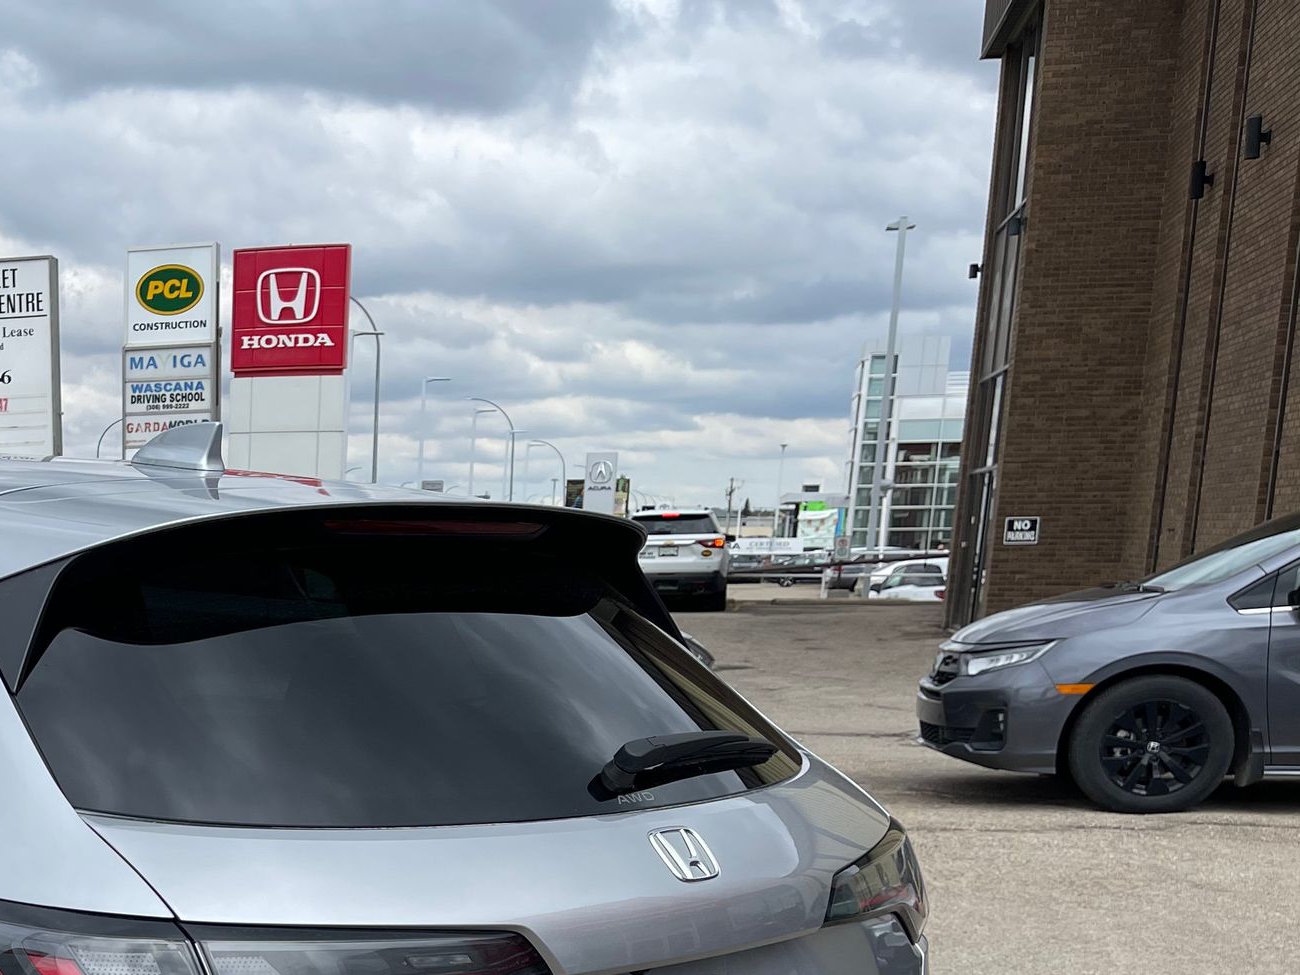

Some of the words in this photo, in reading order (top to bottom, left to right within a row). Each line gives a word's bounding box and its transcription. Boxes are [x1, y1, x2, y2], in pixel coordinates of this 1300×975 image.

[147, 279, 193, 300] PCL
[133, 319, 207, 332] CONSTRUCTION
[2, 327, 34, 338] Lease
[240, 333, 334, 350] HONDA
[131, 381, 205, 393] WASCANA
[130, 393, 167, 404] DRIVING
[169, 392, 205, 403] SCHOOL
[1013, 520, 1031, 530] NO
[617, 791, 655, 805] AWD
